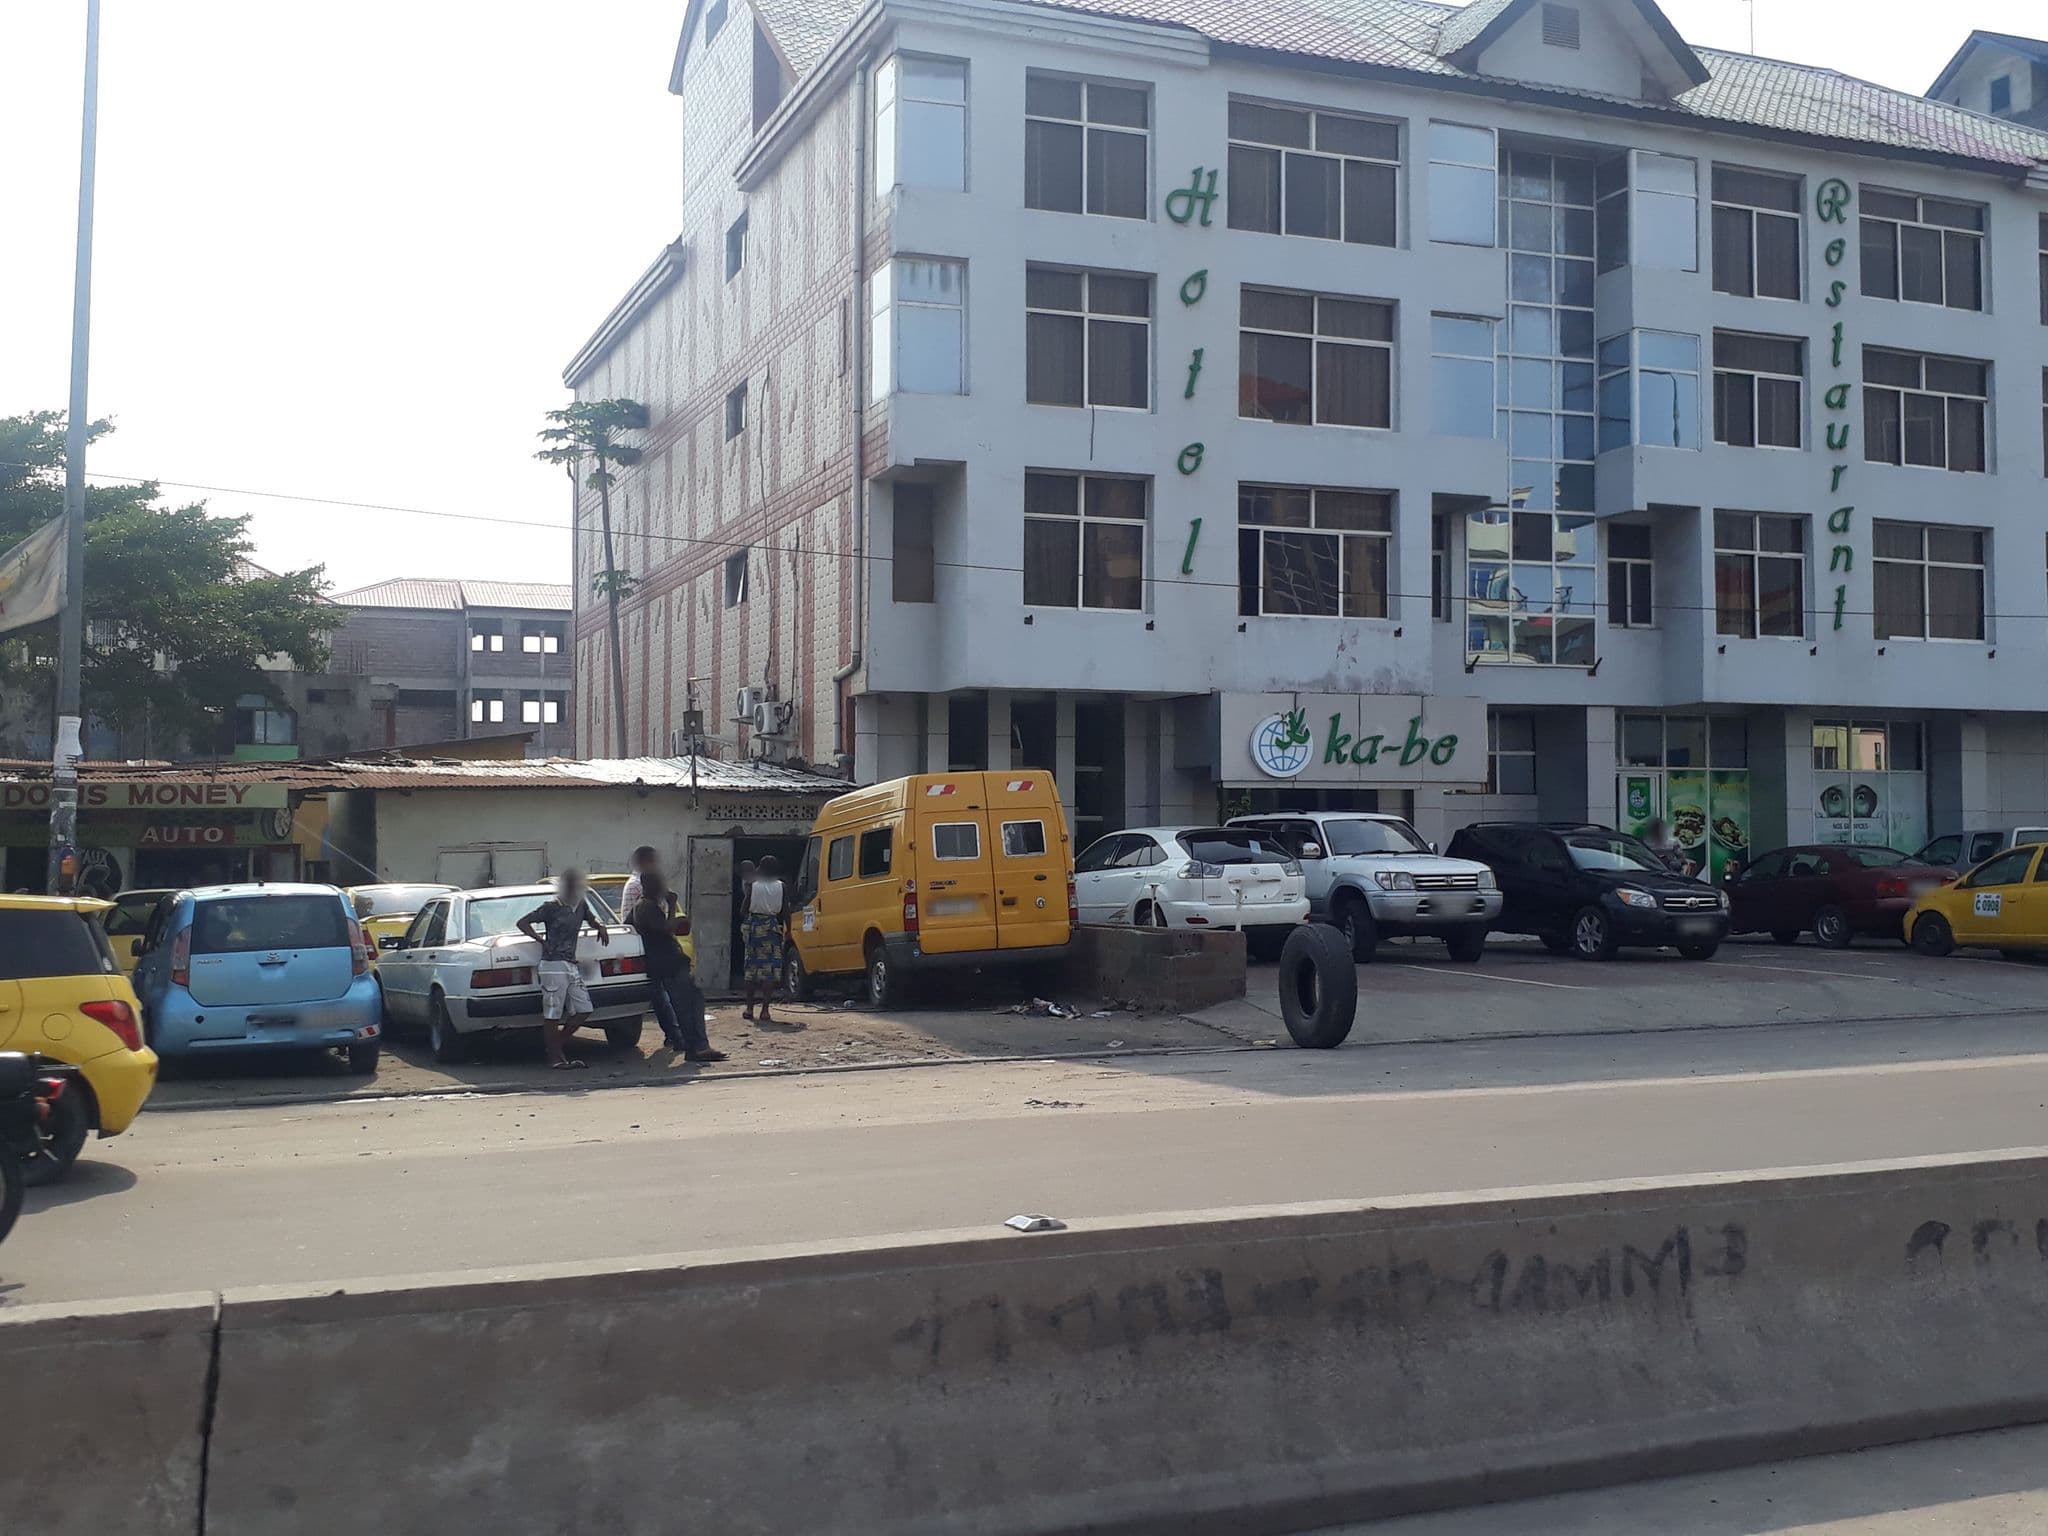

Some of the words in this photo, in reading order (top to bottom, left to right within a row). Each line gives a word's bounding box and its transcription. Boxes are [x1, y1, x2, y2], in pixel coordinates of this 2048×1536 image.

[1166, 166, 1219, 576] Hotel
[1816, 177, 1855, 632] Restaurant
[4, 784, 108, 806] DOIS
[128, 784, 251, 805] MONEY
[141, 826, 224, 843] AUTO
